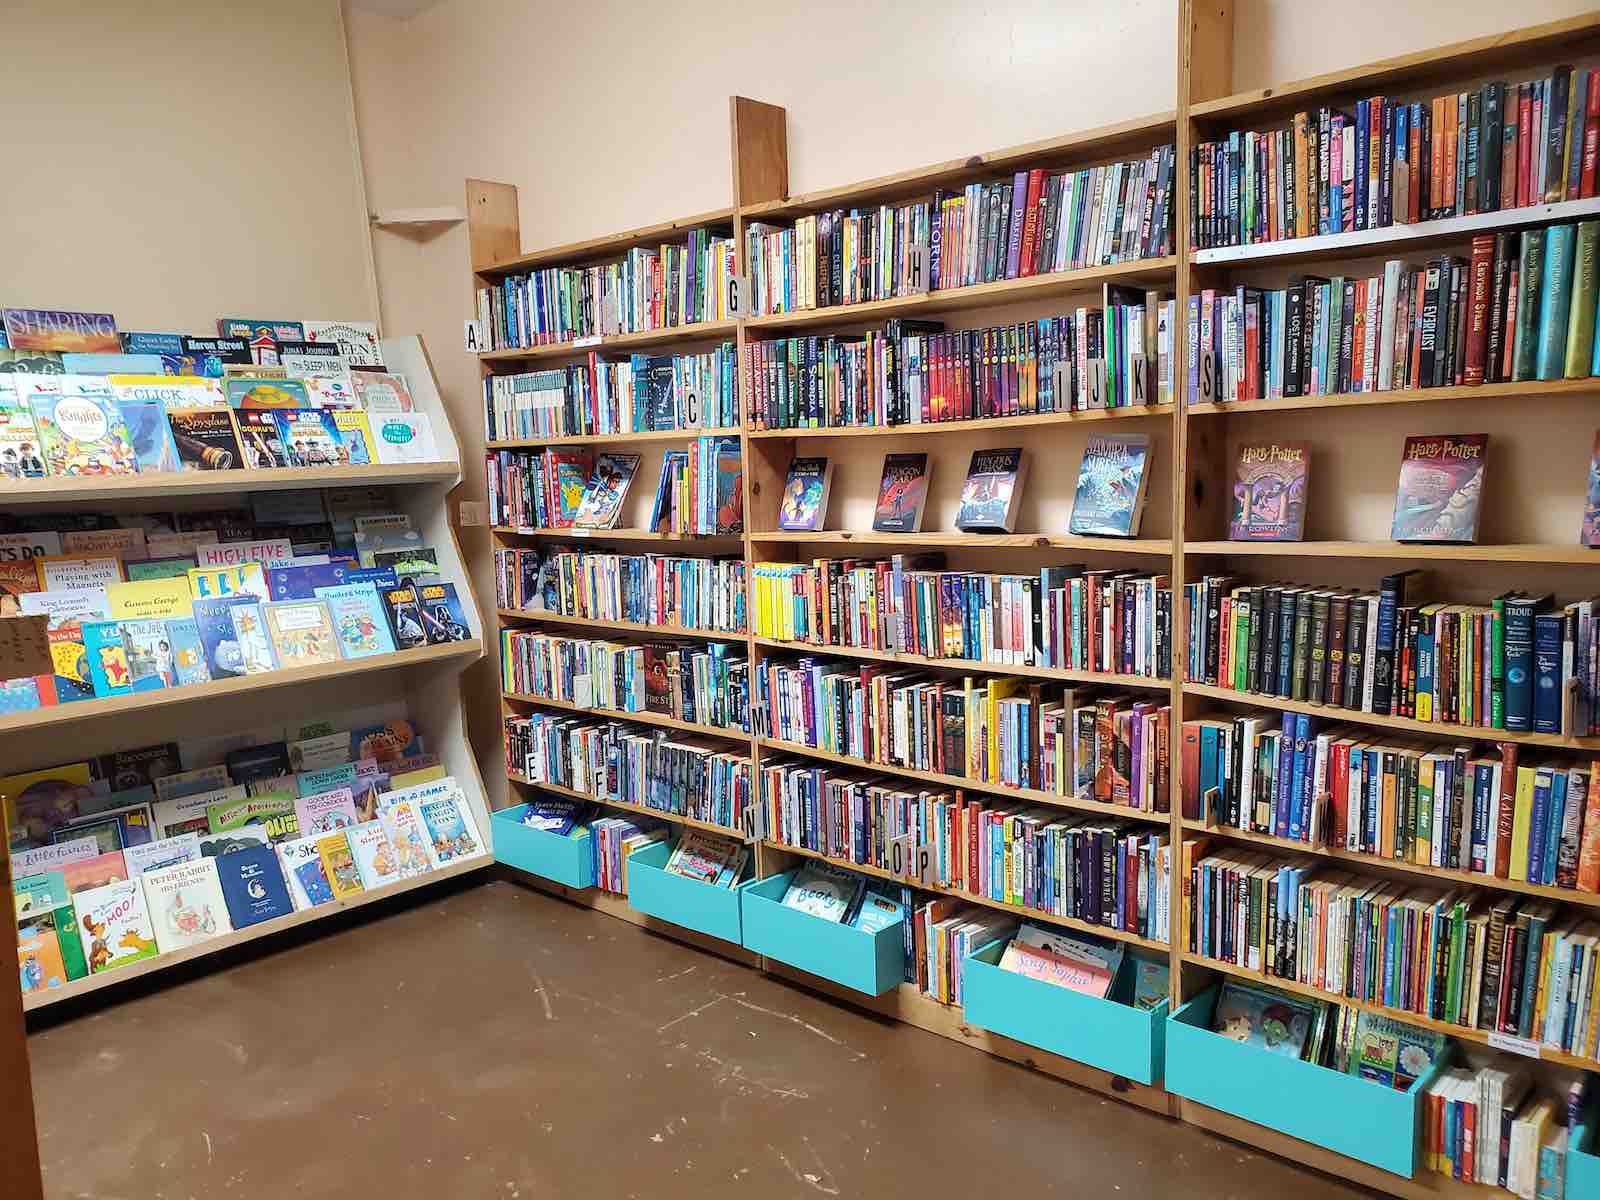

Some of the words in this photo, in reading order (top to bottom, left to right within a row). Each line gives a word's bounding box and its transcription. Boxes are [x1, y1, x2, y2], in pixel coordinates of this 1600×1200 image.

[1319, 133, 1329, 182] STRANDED
[1011, 207, 1024, 252] DARKFALL
[931, 218, 942, 272] TORN
[912, 250, 921, 291] H
[729, 279, 738, 312] G
[7, 310, 115, 336] SHARING
[467, 323, 477, 350] A
[1292, 313, 1300, 333] LOST
[1422, 305, 1437, 352] EVERLOST
[216, 340, 244, 351] Street
[808, 365, 816, 413] SCORPIA
[1092, 362, 1099, 402] J
[1134, 358, 1143, 400] K
[1203, 354, 1212, 398] S
[688, 393, 697, 423] C
[1087, 437, 1128, 461] SAMIRA
[1241, 446, 1269, 464] Harry
[1270, 444, 1302, 463] Potter
[1408, 442, 1442, 460] Harry
[1443, 439, 1480, 460] Potter
[888, 465, 921, 476] DRAGON
[21, 545, 45, 560] DO
[206, 547, 250, 566] HIGH
[251, 544, 284, 560] FIVE
[55, 573, 90, 583] Playing
[91, 571, 113, 581] with
[66, 581, 105, 591] Magnets
[125, 599, 153, 608] Curious
[154, 596, 179, 606] George
[883, 617, 893, 649] L
[752, 707, 764, 736] M
[529, 756, 537, 780] E
[595, 771, 603, 800] F
[432, 813, 457, 825] TOYS
[745, 807, 755, 839] N
[892, 842, 902, 875] O
[920, 850, 929, 883] P
[151, 871, 180, 886] PETER
[180, 864, 213, 878] RABBIT
[106, 895, 136, 926] MOO!
[1487, 911, 1504, 962] LUPICA
